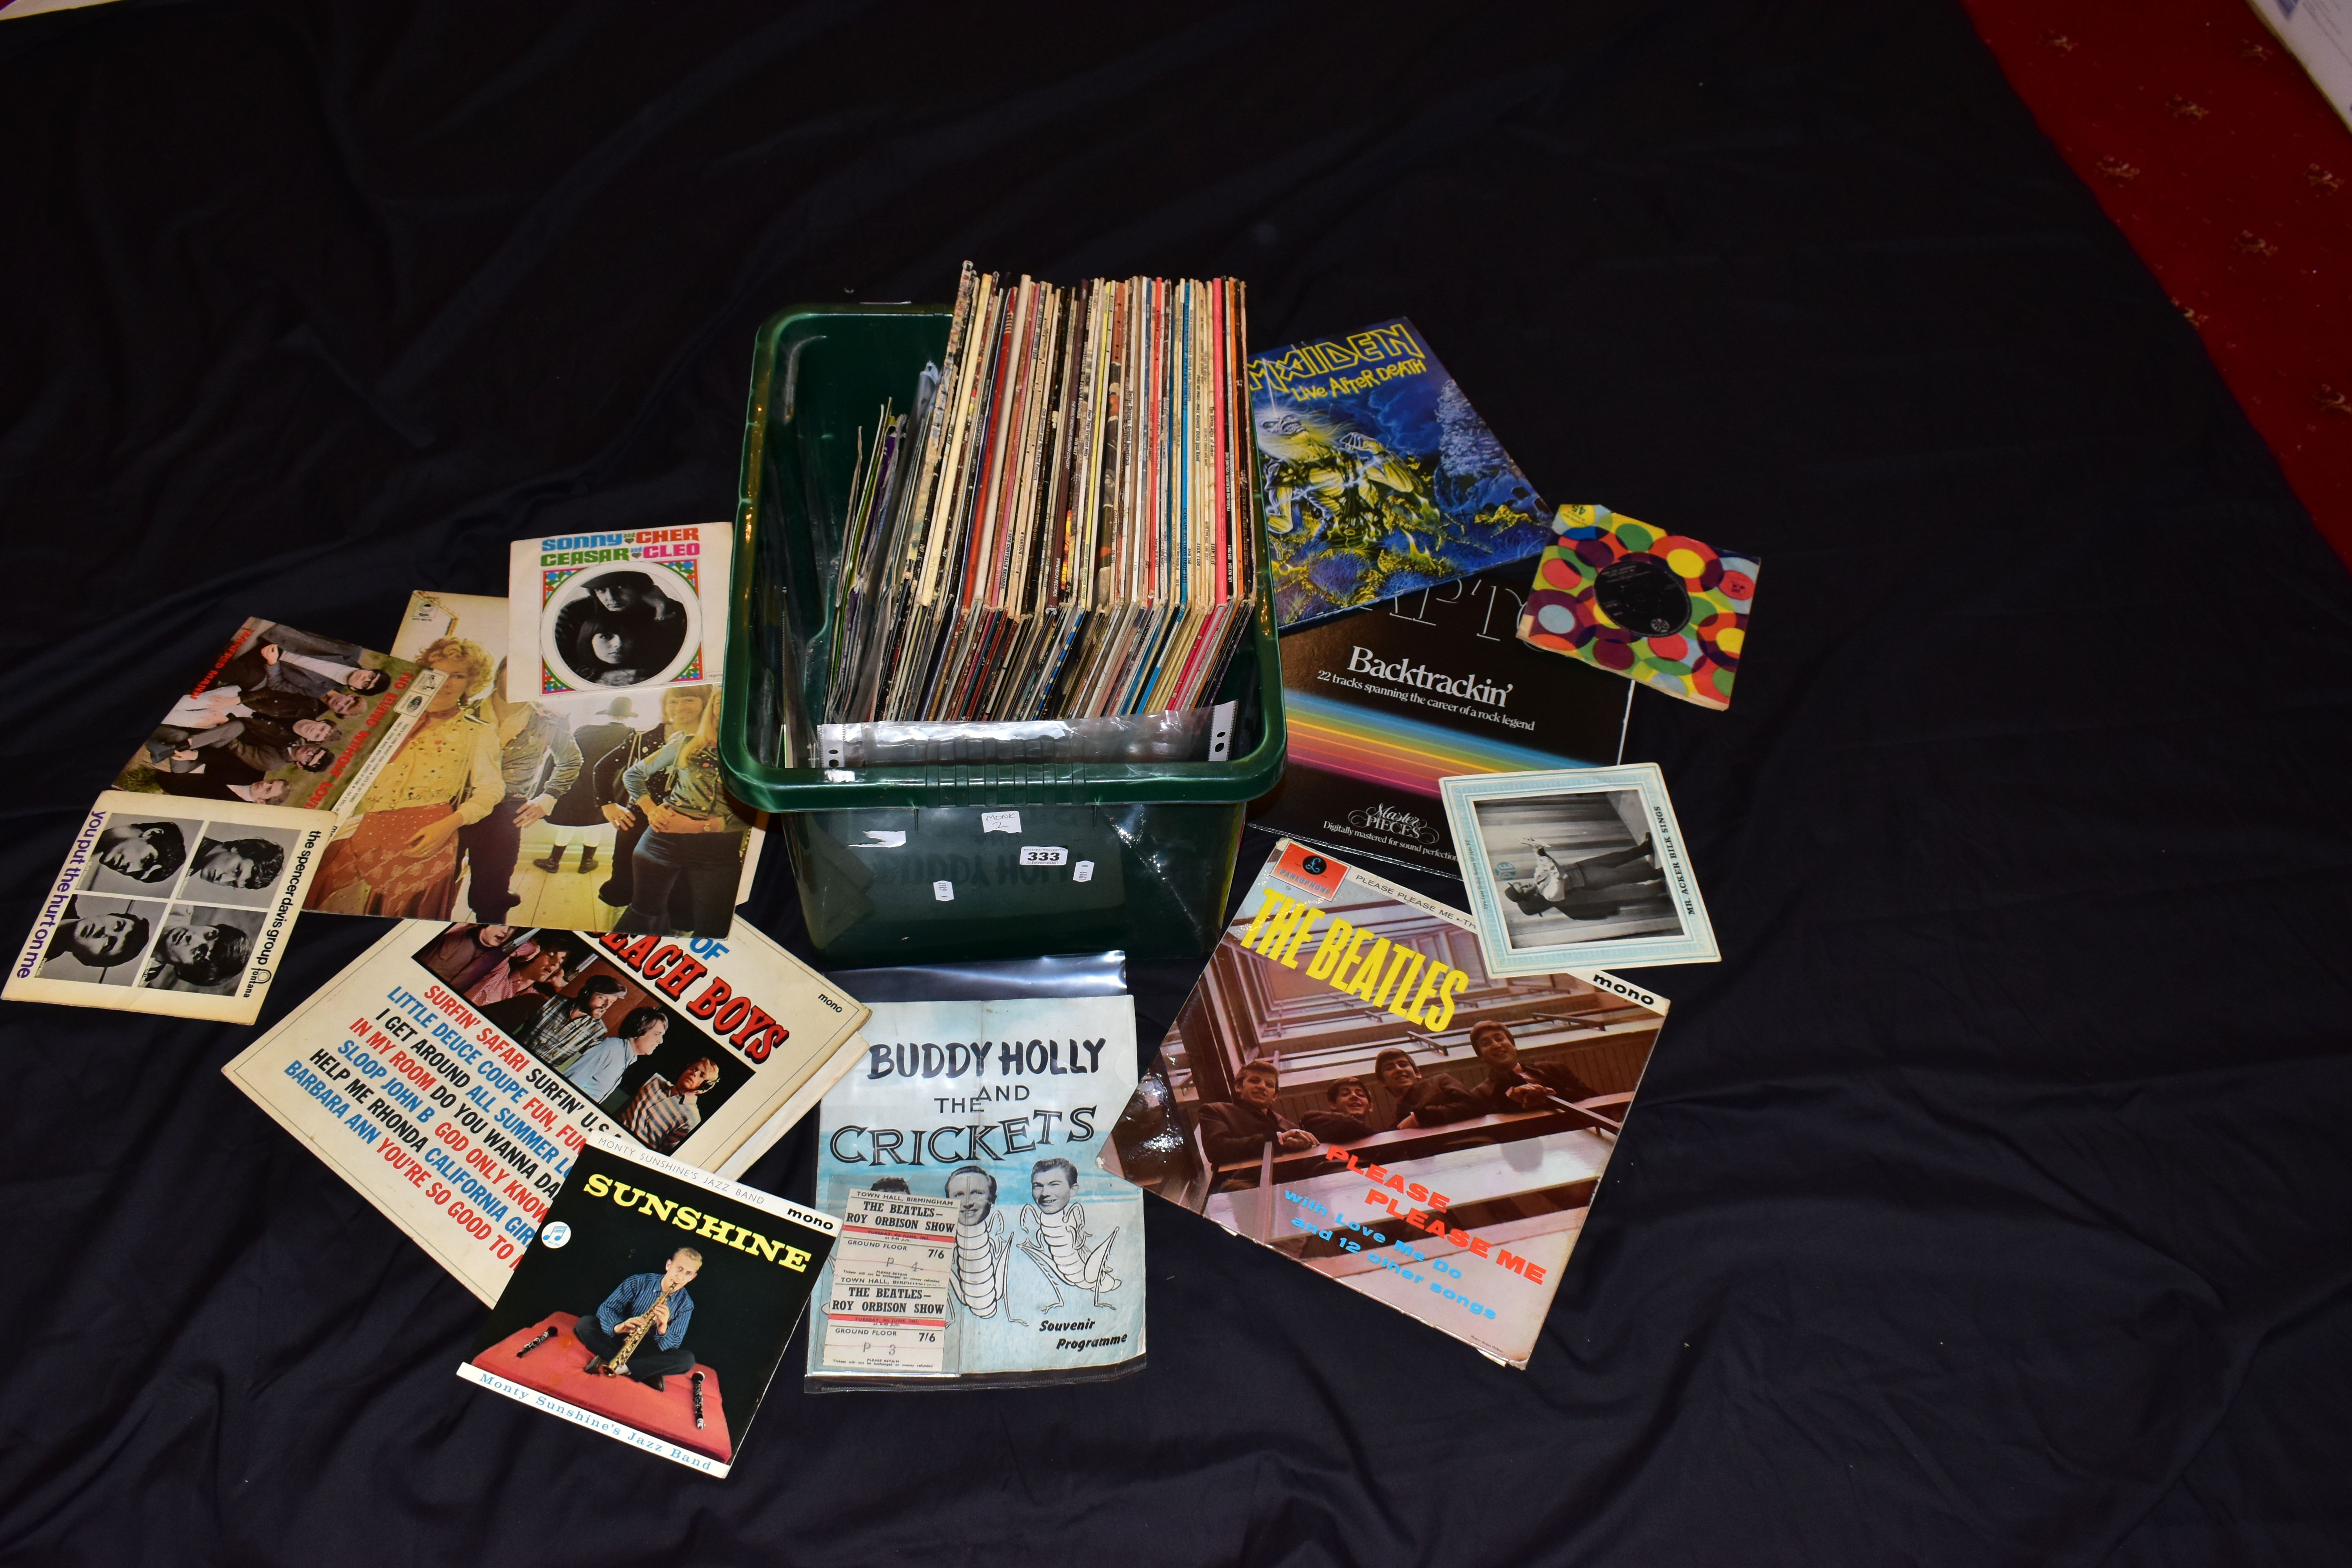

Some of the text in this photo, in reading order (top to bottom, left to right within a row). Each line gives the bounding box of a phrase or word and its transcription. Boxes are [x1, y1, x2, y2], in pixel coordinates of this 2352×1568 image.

[1247, 323, 1425, 392] MAIDEN
[540, 547, 630, 567] CEASAR
[643, 543, 700, 559] CLEO
[636, 527, 699, 544] CHER
[1317, 670, 1535, 731] 22 tracks spanning the career of a rock legend
[986, 813, 1017, 821] MONK
[1366, 803, 1427, 828] Master
[1366, 815, 1421, 839] PIECES
[1027, 852, 1060, 862] 333
[1323, 821, 1459, 862] Digitally mastered for sound perfection
[1653, 806, 1695, 915] MR. ACKER BILK SINGS
[16, 806, 106, 981] you put the hurt on me
[254, 828, 321, 967] the spencer davis group
[1279, 869, 1330, 895] PARLOPHONE
[1356, 874, 1455, 920] PLEASE PLEASE ME
[689, 937, 730, 961] OF
[1240, 887, 1469, 1033] THE BEATLES
[243, 967, 262, 998] fontana
[587, 931, 789, 1064] EACH BOYS
[818, 993, 842, 1013] mono
[1593, 974, 1654, 1005] mono
[387, 985, 433, 1029] LITTLE
[430, 1024, 483, 1066] DEUCE
[476, 1060, 529, 1104] COUPE
[522, 1096, 557, 1133] FUN,
[475, 1027, 530, 1073] SAFARI
[867, 1038, 1106, 1080] BUDDY HOLLY
[348, 1017, 372, 1040] IN
[365, 1031, 394, 1061] MY
[388, 1051, 437, 1092] ROOM
[430, 1085, 456, 1109] DO
[452, 1102, 485, 1135] YOU
[483, 1127, 541, 1180] WANNA
[375, 1008, 559, 1165] I GET AROUND ALL SUMMER
[934, 1098, 984, 1113] THE
[976, 1085, 1031, 1102] AND
[336, 1039, 388, 1080] SLOOP
[379, 1076, 430, 1116] JOHN
[415, 1105, 436, 1125] B
[434, 1121, 468, 1156] GOD
[465, 1147, 511, 1185] ONLY
[309, 1048, 536, 1249] HELP ME RHONDA CALIFORNIA GIR
[829, 1105, 1098, 1167] CRICKETS
[284, 1060, 515, 1260] BARBARA ANN YOU'RE SO GOOD TO
[598, 1136, 637, 1157] MONTY
[703, 1176, 730, 1194] JAZZ
[735, 1187, 765, 1205] BAND
[1325, 1145, 1451, 1214] PLEASE
[786, 1207, 834, 1231] mono
[864, 1201, 884, 1212] THE
[907, 1196, 953, 1206] BIRMINGHAM
[583, 1173, 812, 1273] SUNSHINE
[846, 1212, 955, 1233] ROY ORBISON SHOW
[1284, 1189, 1462, 1280] with Love Me Do
[1365, 1188, 1547, 1285] PLEASE ME
[886, 1257, 894, 1267] P
[1291, 1216, 1497, 1321] and 12 other songs
[832, 1300, 944, 1314] ROY ORBISON SHOW
[849, 1287, 870, 1298] THE
[1039, 1318, 1096, 1332] Souvenir
[1056, 1334, 1127, 1352] Programme
[478, 1372, 529, 1401] Monty
[626, 1429, 663, 1453] Jazz
[670, 1446, 713, 1471] Band
